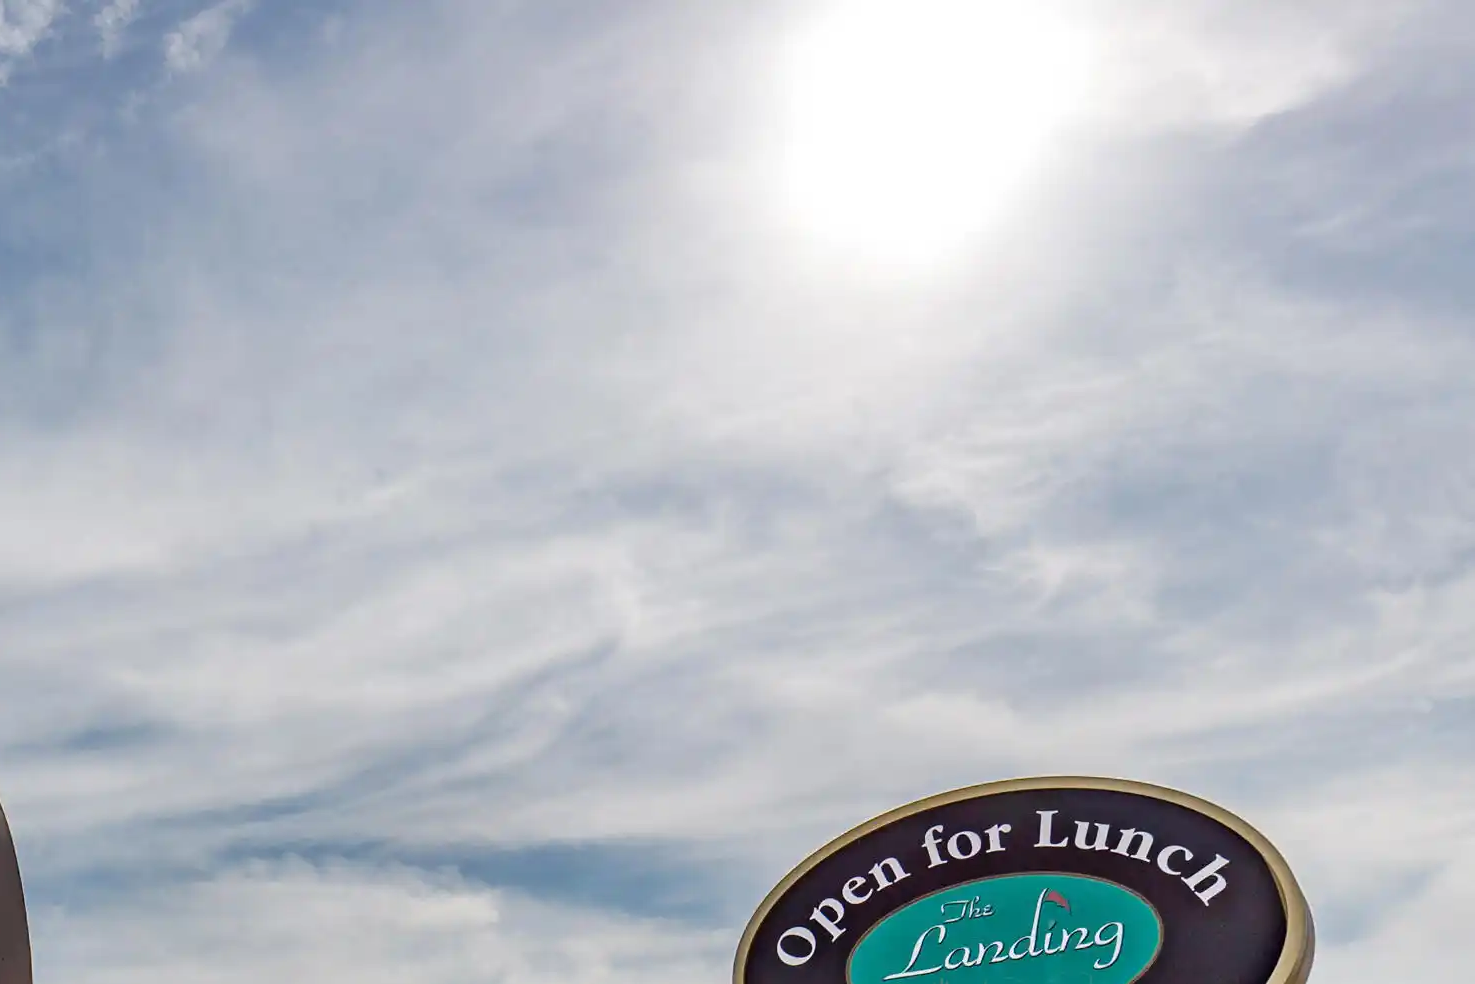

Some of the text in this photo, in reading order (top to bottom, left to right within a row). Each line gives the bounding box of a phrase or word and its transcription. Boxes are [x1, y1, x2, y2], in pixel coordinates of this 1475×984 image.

[777, 810, 1230, 966] Open for Lunch
[882, 888, 1125, 981] Landing
[940, 896, 996, 923] The
